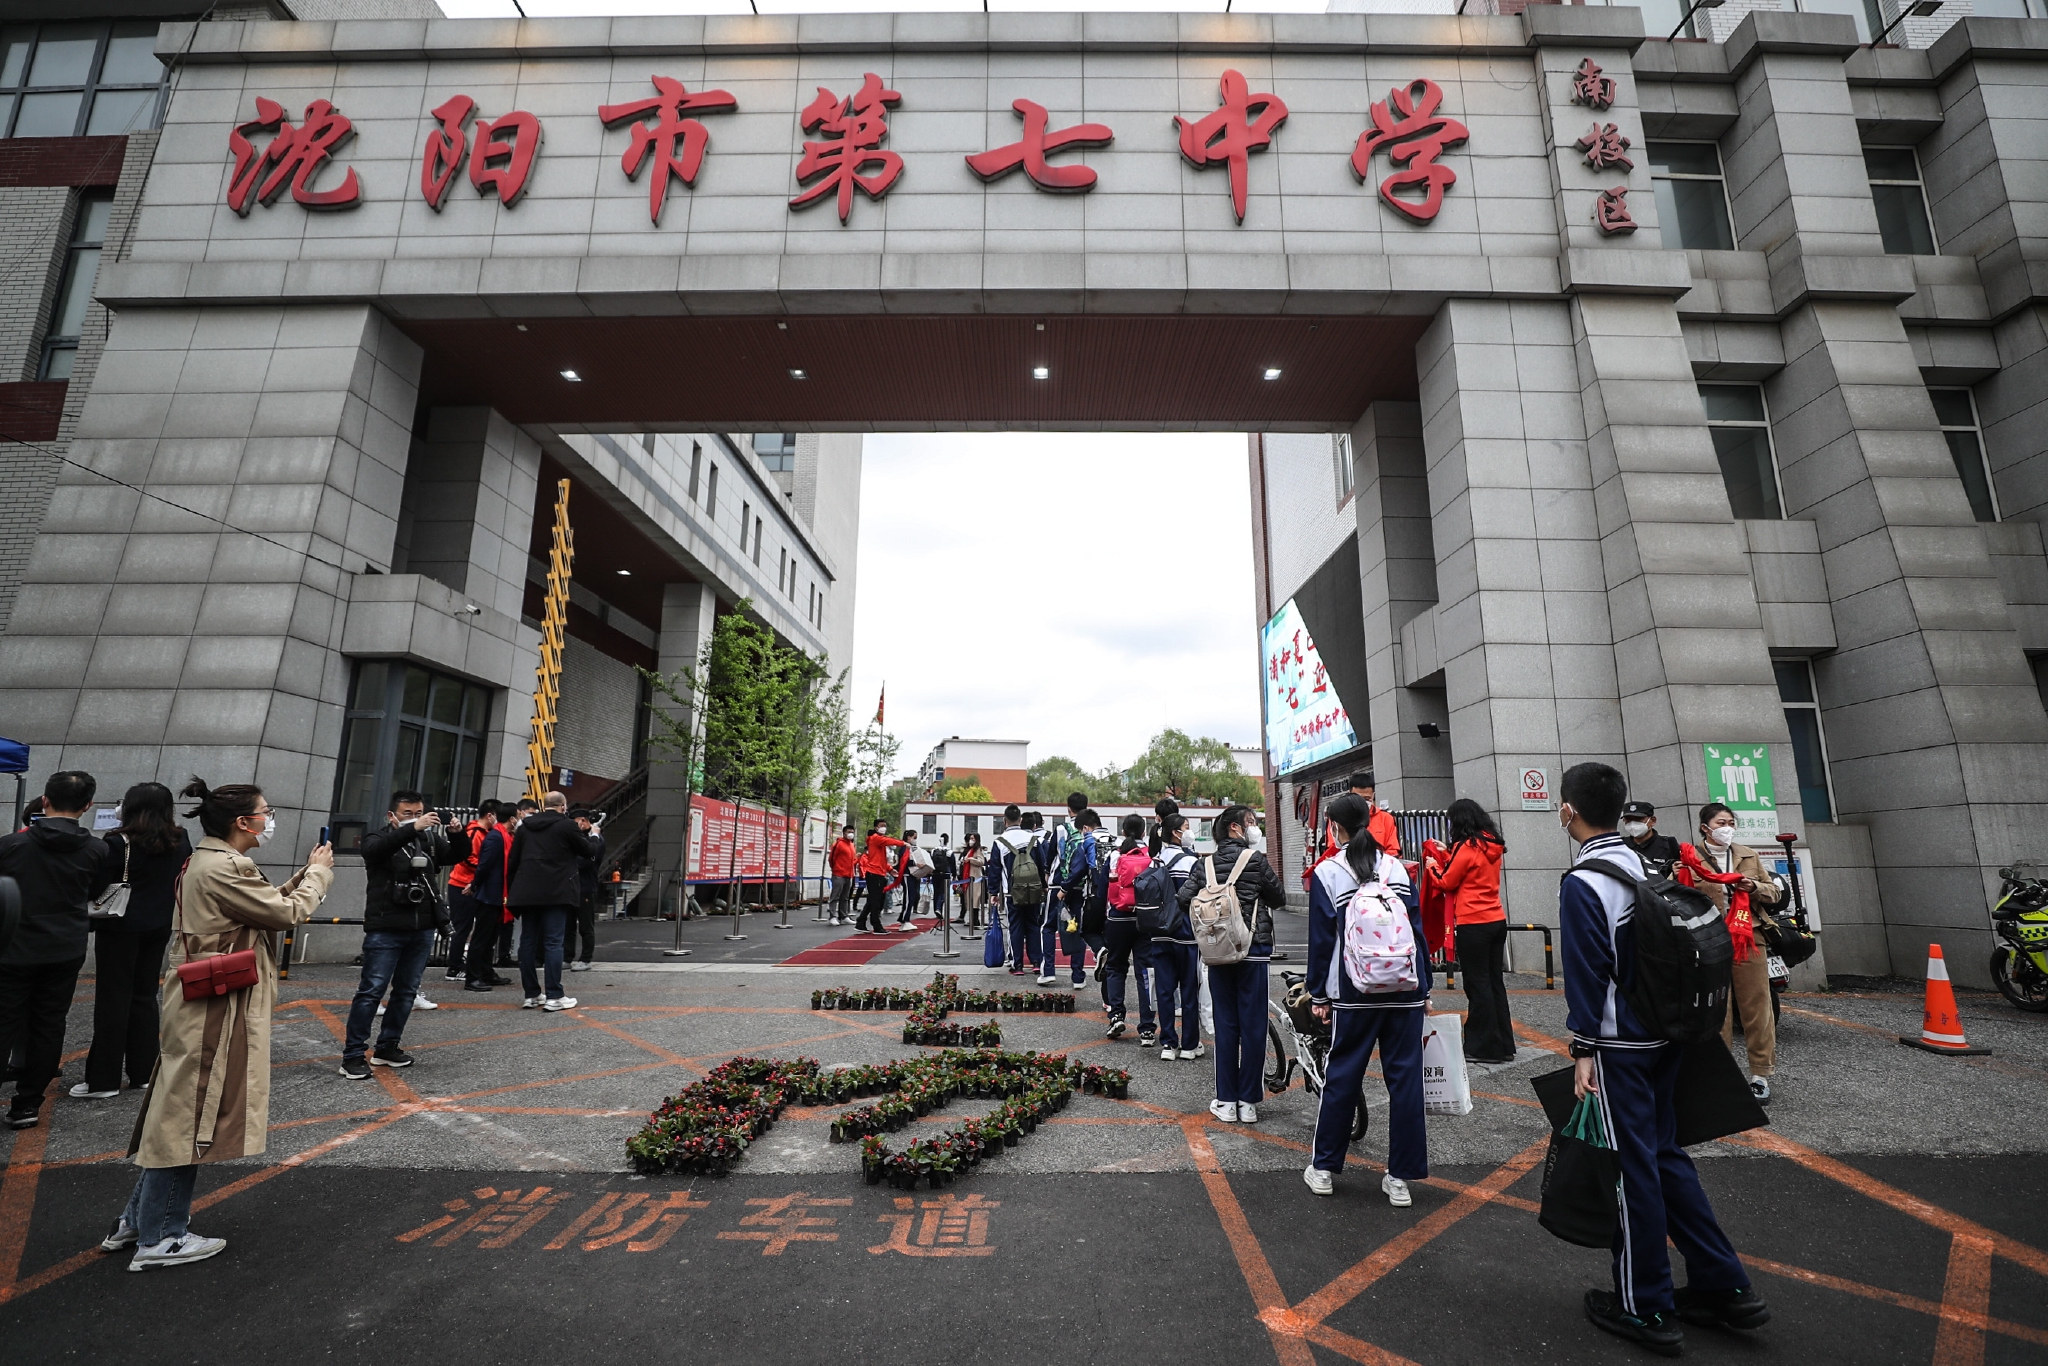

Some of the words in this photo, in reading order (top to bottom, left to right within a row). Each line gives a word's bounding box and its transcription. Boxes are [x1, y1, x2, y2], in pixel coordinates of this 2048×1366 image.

[228, 69, 1470, 226] 沈阳市第七中学
[1573, 57, 1638, 232] 南校区
[395, 1186, 1001, 1257] 消防车道
